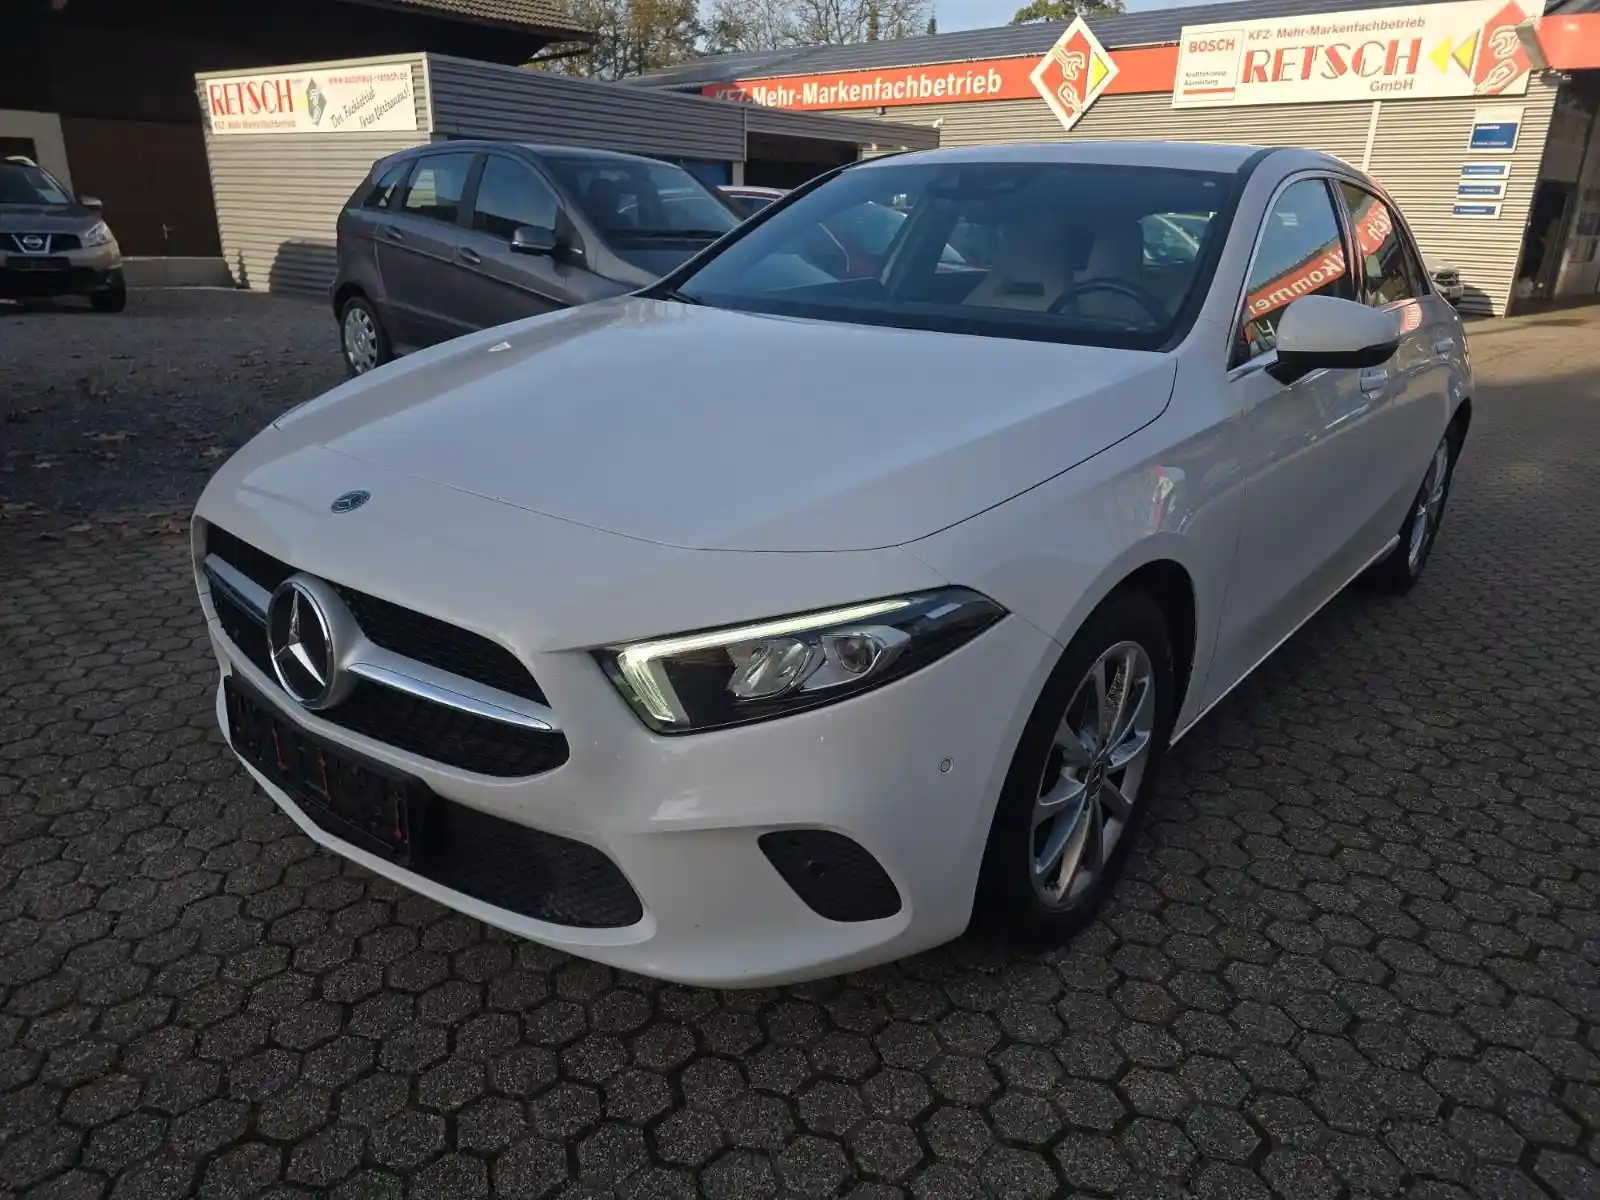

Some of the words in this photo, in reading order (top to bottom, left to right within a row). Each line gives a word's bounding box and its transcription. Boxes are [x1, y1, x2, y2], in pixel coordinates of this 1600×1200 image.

[1248, 29, 1273, 41] KFZ-
[1277, 16, 1426, 40] Mehr-Markenfachbetrieb
[1188, 37, 1235, 53] BOSCH
[1242, 38, 1421, 84] RETSCH
[209, 79, 293, 116] RETSCH
[1369, 78, 1414, 92] GmbH
